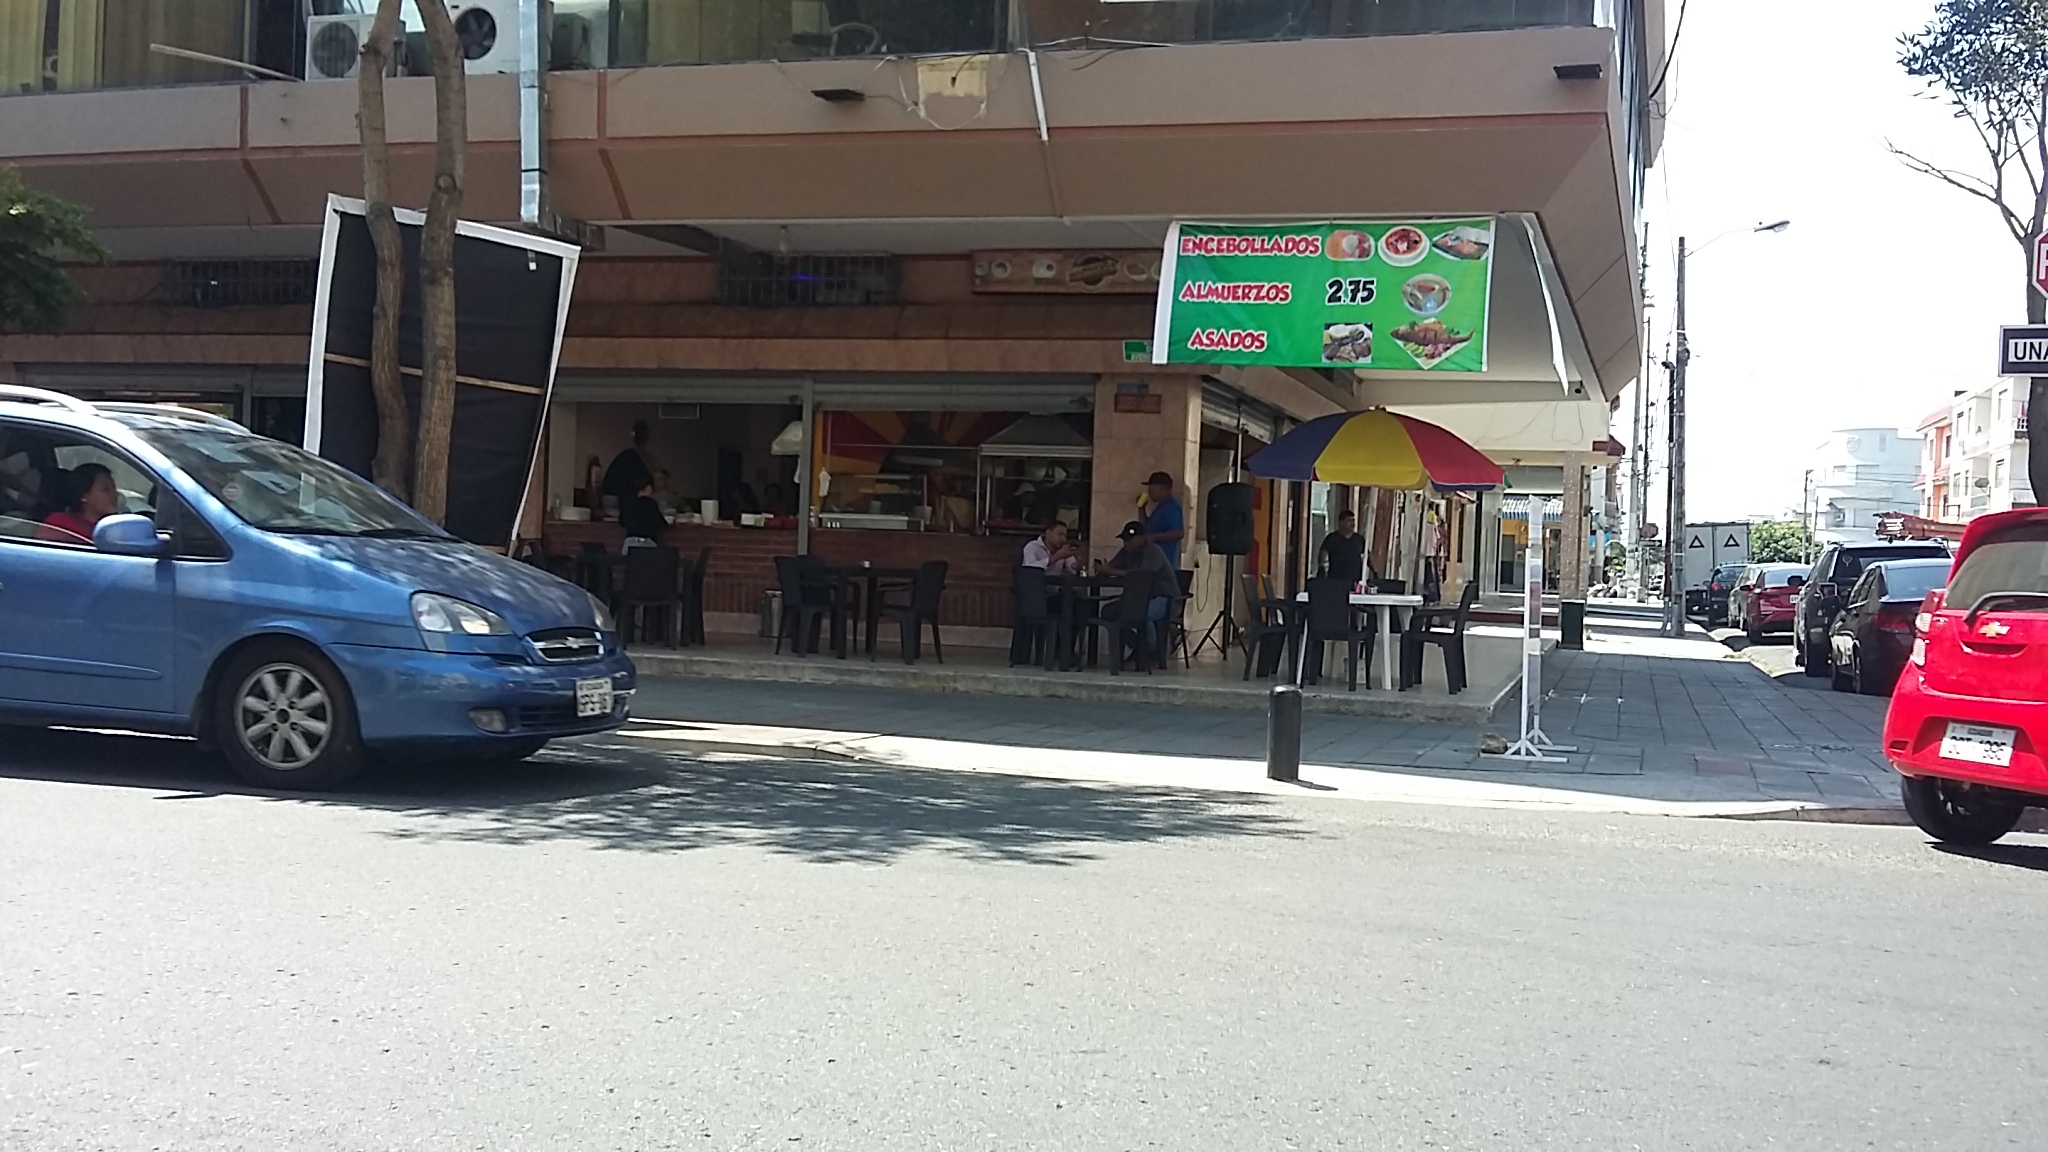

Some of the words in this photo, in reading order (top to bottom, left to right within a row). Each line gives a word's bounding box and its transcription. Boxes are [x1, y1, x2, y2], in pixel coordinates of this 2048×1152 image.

[1180, 236, 1321, 256] ENCEBOLLADOS
[1180, 281, 1291, 303] ALMUERZOS
[1326, 278, 1376, 305] 2.75
[1188, 328, 1267, 351] ASADOS
